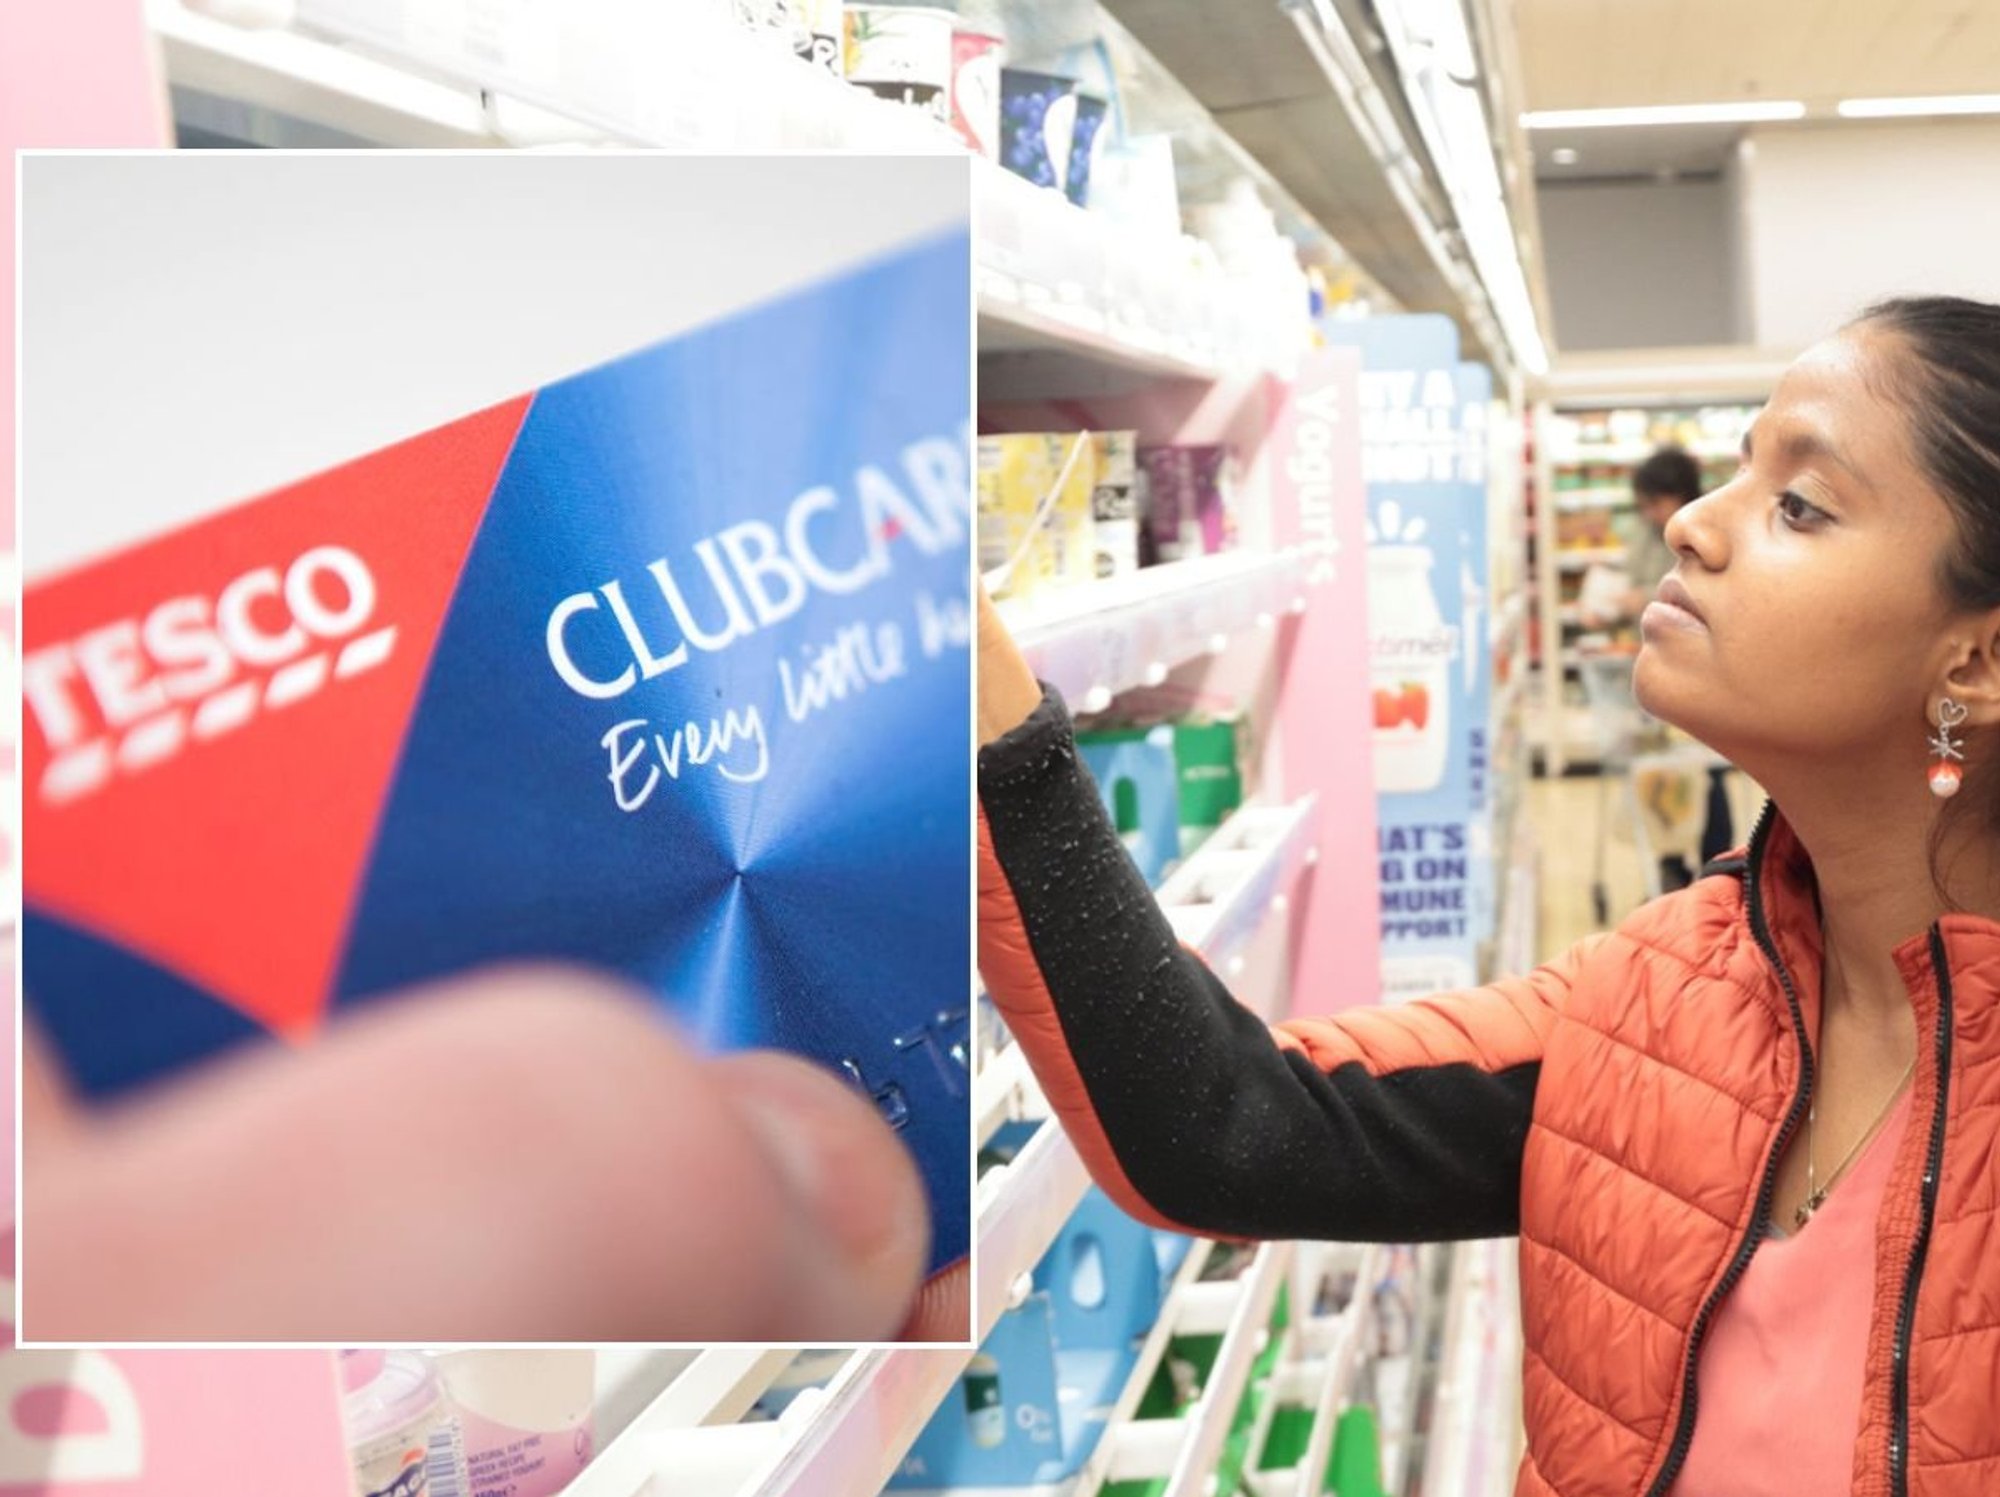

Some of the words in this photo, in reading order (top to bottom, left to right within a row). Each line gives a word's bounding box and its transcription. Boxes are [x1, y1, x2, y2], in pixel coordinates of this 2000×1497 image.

[546, 417, 970, 699] CLUBCAR
[1287, 384, 1342, 585] Yogurts
[22, 544, 377, 750] TESCO
[601, 704, 769, 812] Every
[778, 621, 907, 722] little
[1415, 858, 1466, 882] ON
